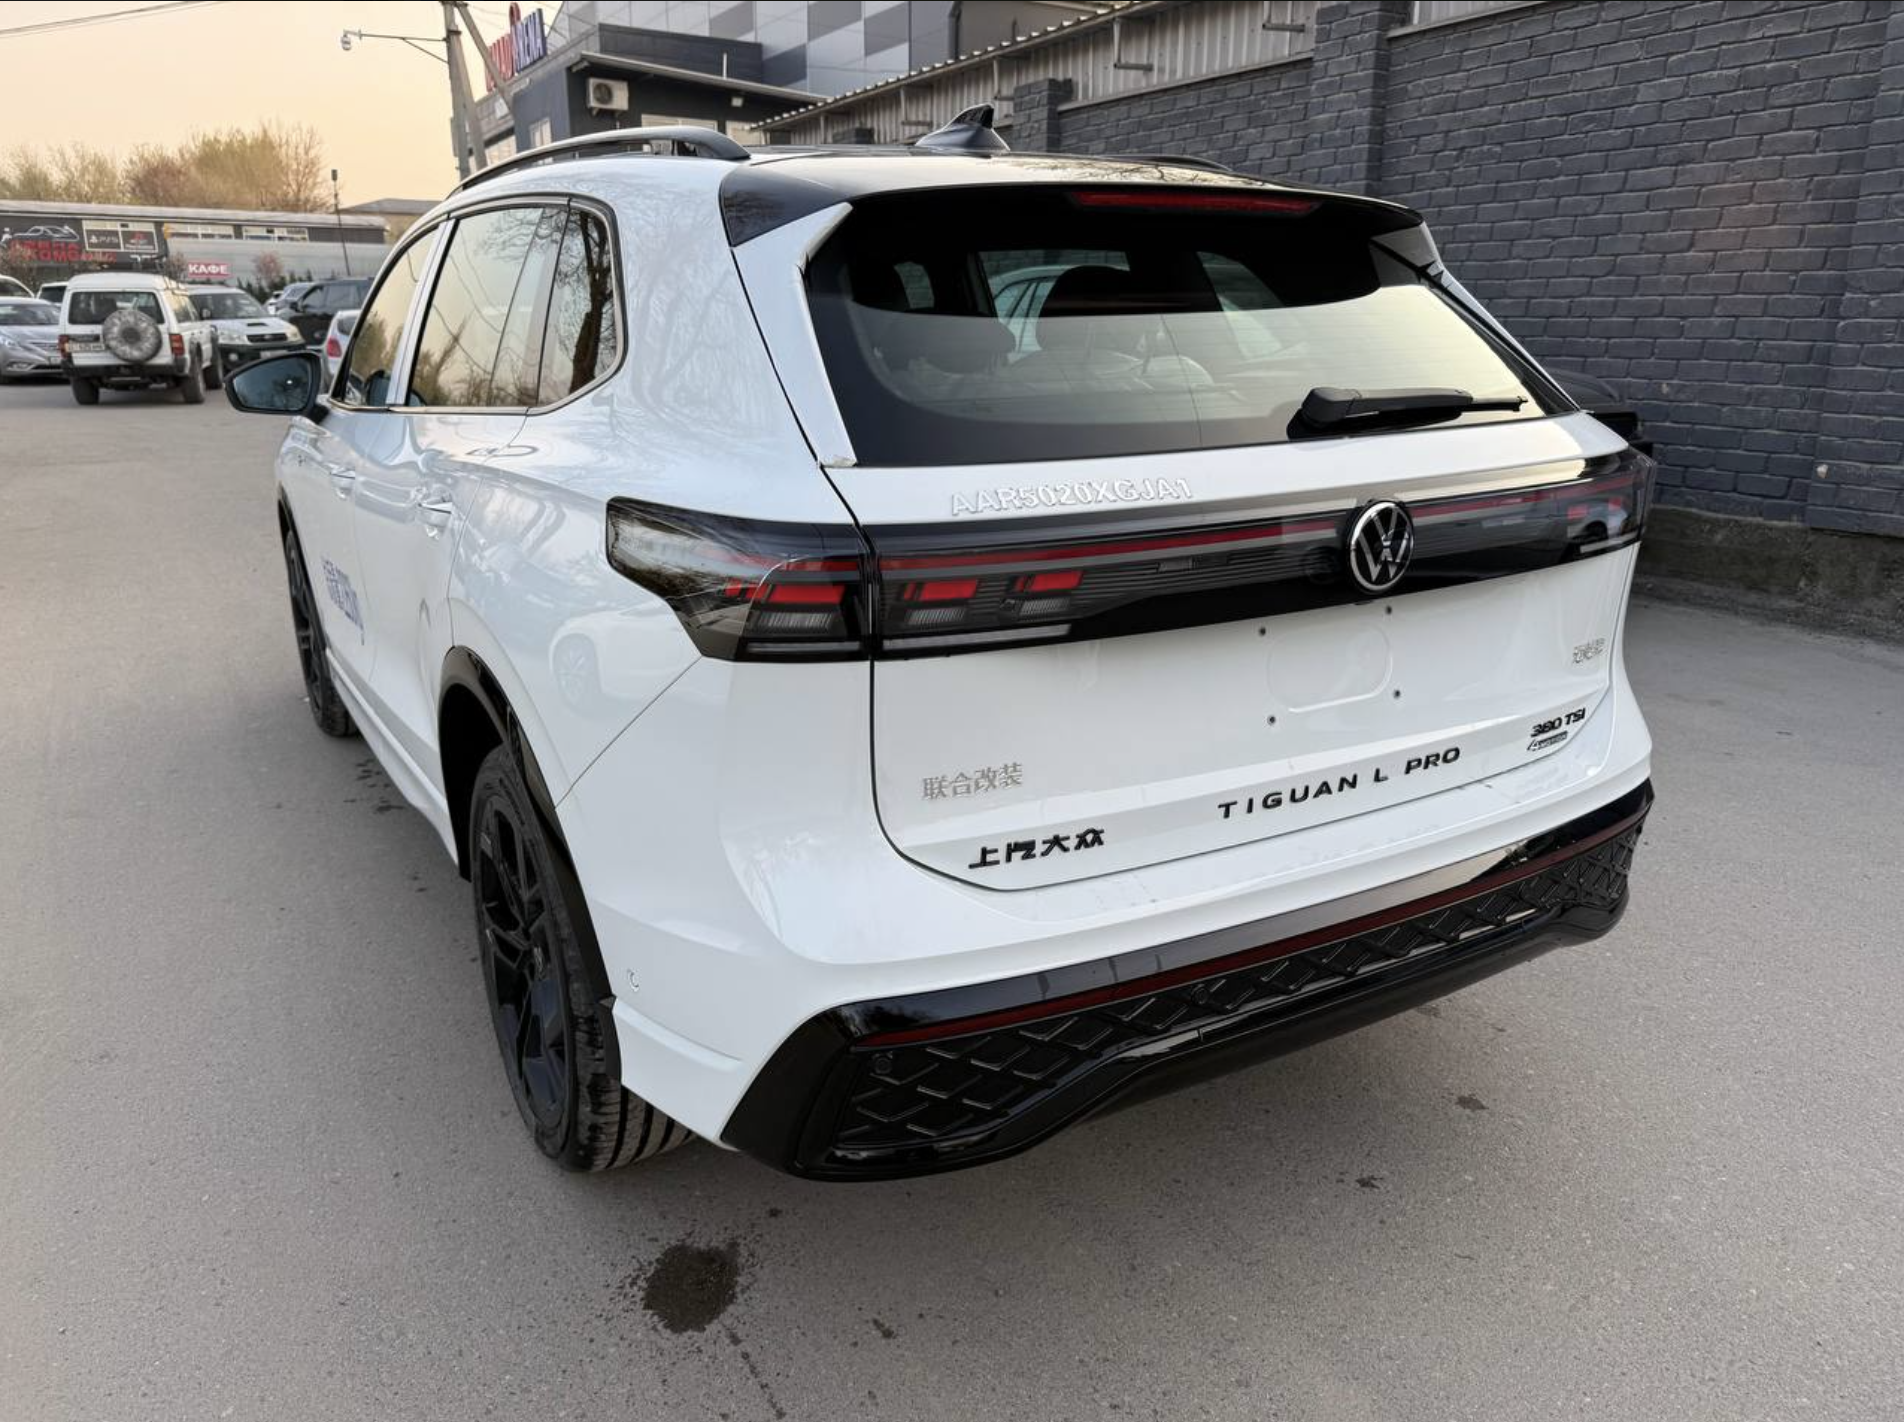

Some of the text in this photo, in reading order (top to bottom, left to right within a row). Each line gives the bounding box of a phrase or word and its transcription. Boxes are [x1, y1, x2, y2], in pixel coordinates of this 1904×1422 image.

[188, 263, 229, 275] КАФЕ
[951, 477, 1193, 517] AAR5020XGJA1
[1564, 707, 1586, 726] TSI
[922, 761, 1024, 801] 联合改装
[1217, 746, 1461, 819] TIGUAN L PRO
[968, 827, 1105, 870] 上汽大众
